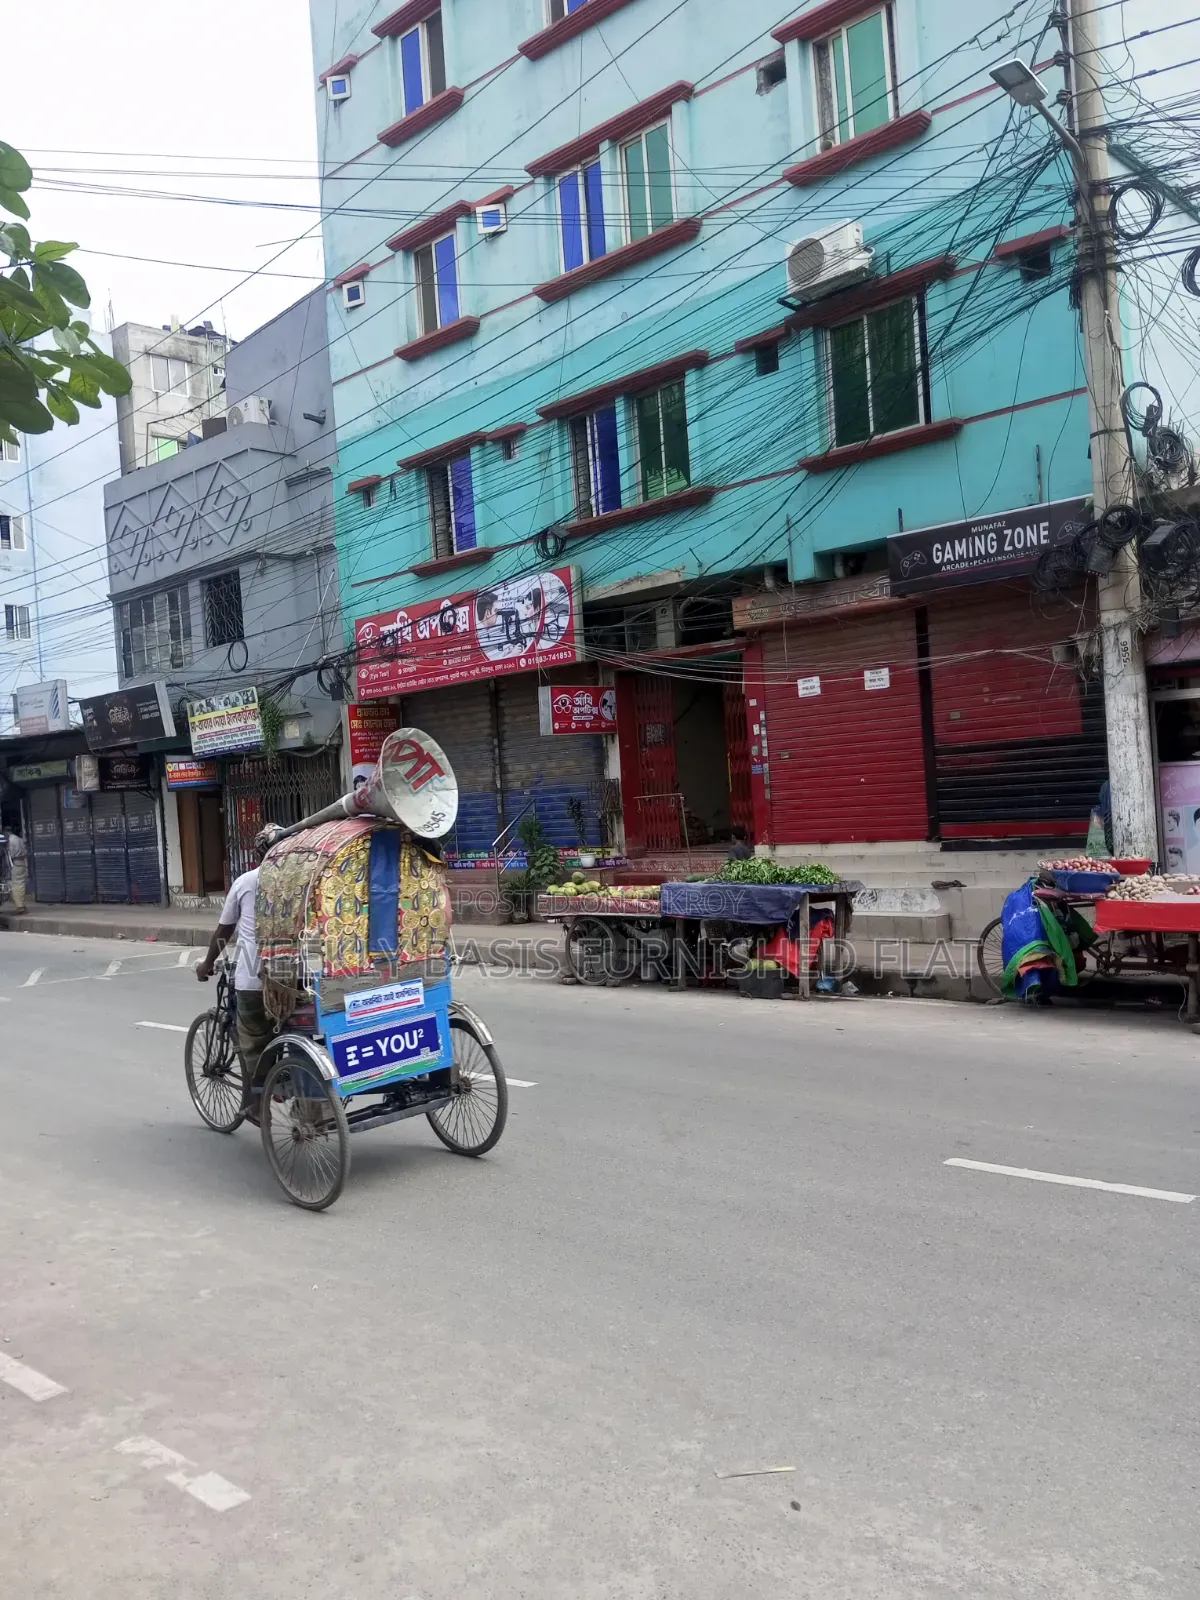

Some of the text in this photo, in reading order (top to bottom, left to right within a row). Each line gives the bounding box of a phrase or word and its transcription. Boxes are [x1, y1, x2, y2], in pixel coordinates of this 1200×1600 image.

[971, 521, 1006, 533] MUNAFAZ
[932, 521, 1050, 564] GAMING ZONE
